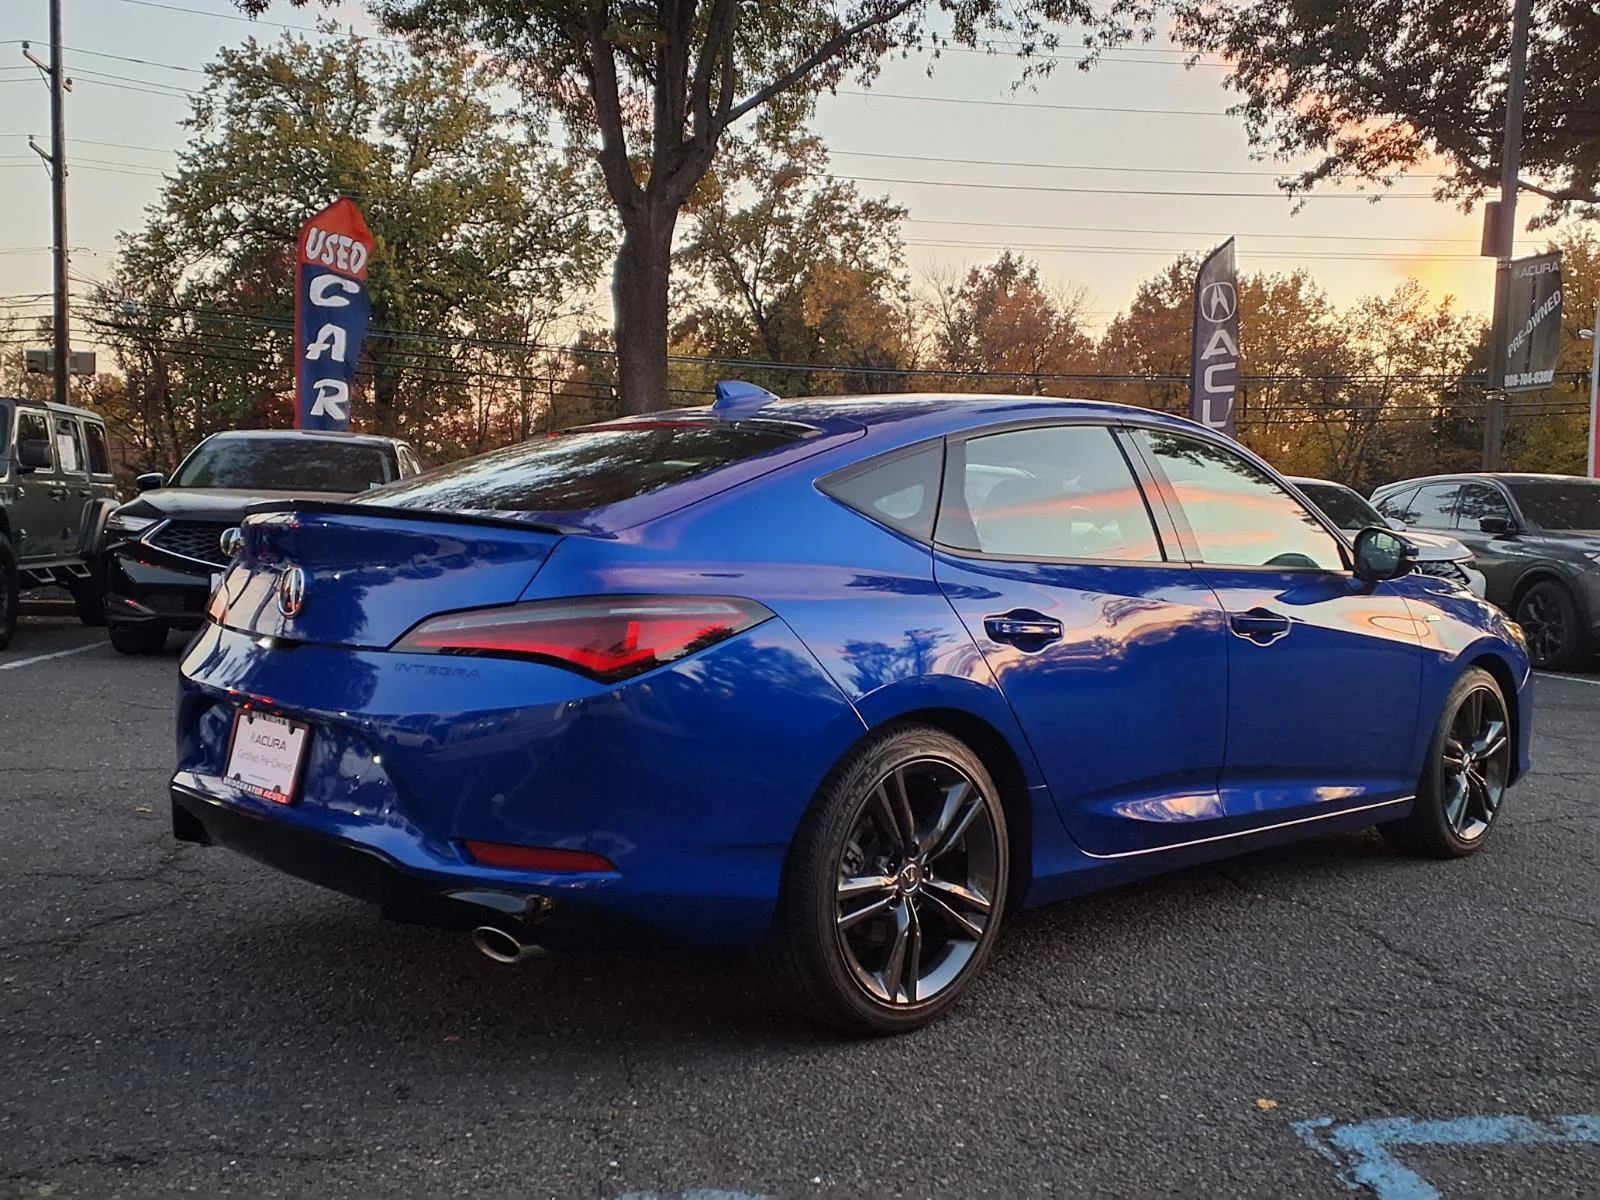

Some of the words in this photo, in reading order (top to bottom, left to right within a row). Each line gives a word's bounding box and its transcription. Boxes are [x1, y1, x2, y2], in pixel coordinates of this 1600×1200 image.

[305, 226, 367, 274] USED
[1519, 261, 1560, 278] ACURA
[1508, 290, 1561, 358] PRE-OWNED
[305, 274, 360, 420] CAR
[394, 662, 481, 679] INTEGRA
[255, 734, 286, 751] ACURA
[263, 791, 288, 803] ACURA
